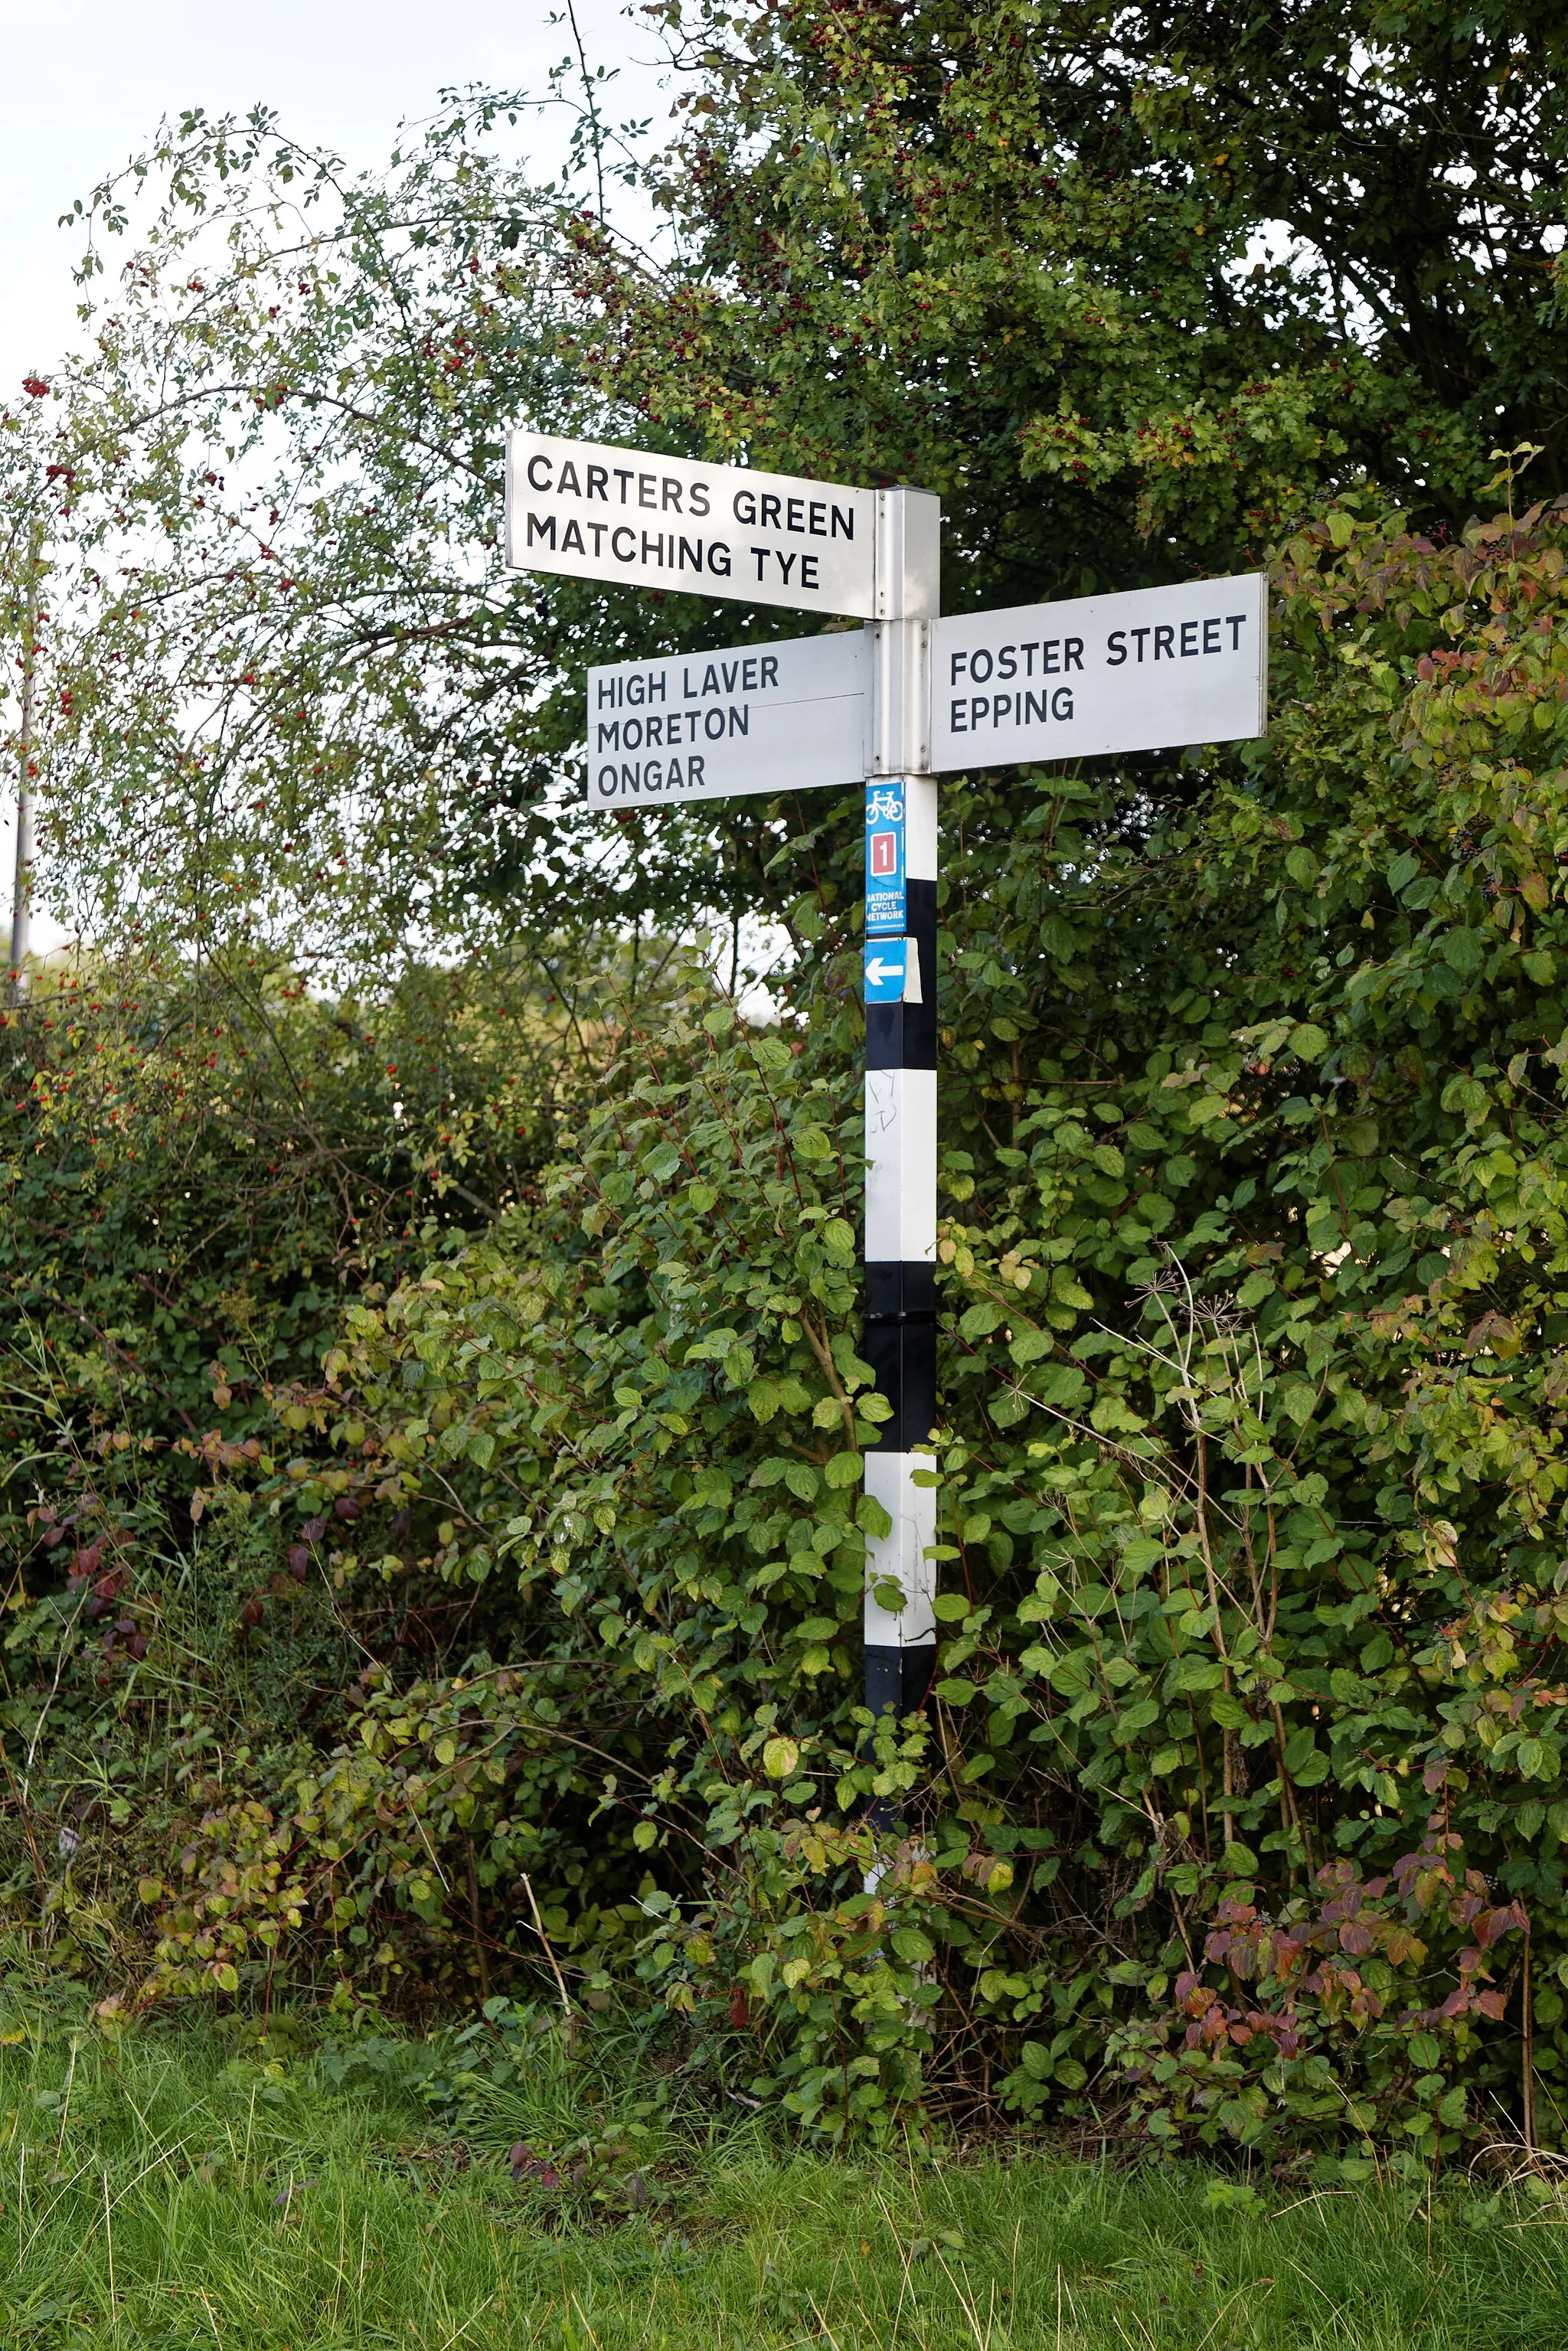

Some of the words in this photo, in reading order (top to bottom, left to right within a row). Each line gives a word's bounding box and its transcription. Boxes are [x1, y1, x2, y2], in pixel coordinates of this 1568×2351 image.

[527, 455, 710, 517] CARTERS
[733, 490, 854, 540] GREEN
[527, 512, 731, 577] MATCHING
[750, 547, 820, 590] TYE
[950, 637, 1085, 687] FOSTER
[1106, 614, 1246, 667] STREET
[597, 671, 666, 710] HIGH
[684, 655, 779, 700] LAVER
[597, 704, 749, 754] MORETON
[950, 687, 1074, 733] EPPING
[597, 755, 706, 797] ONGAR
[879, 841, 887, 867] 1
[871, 901, 897, 912] CYCLE
